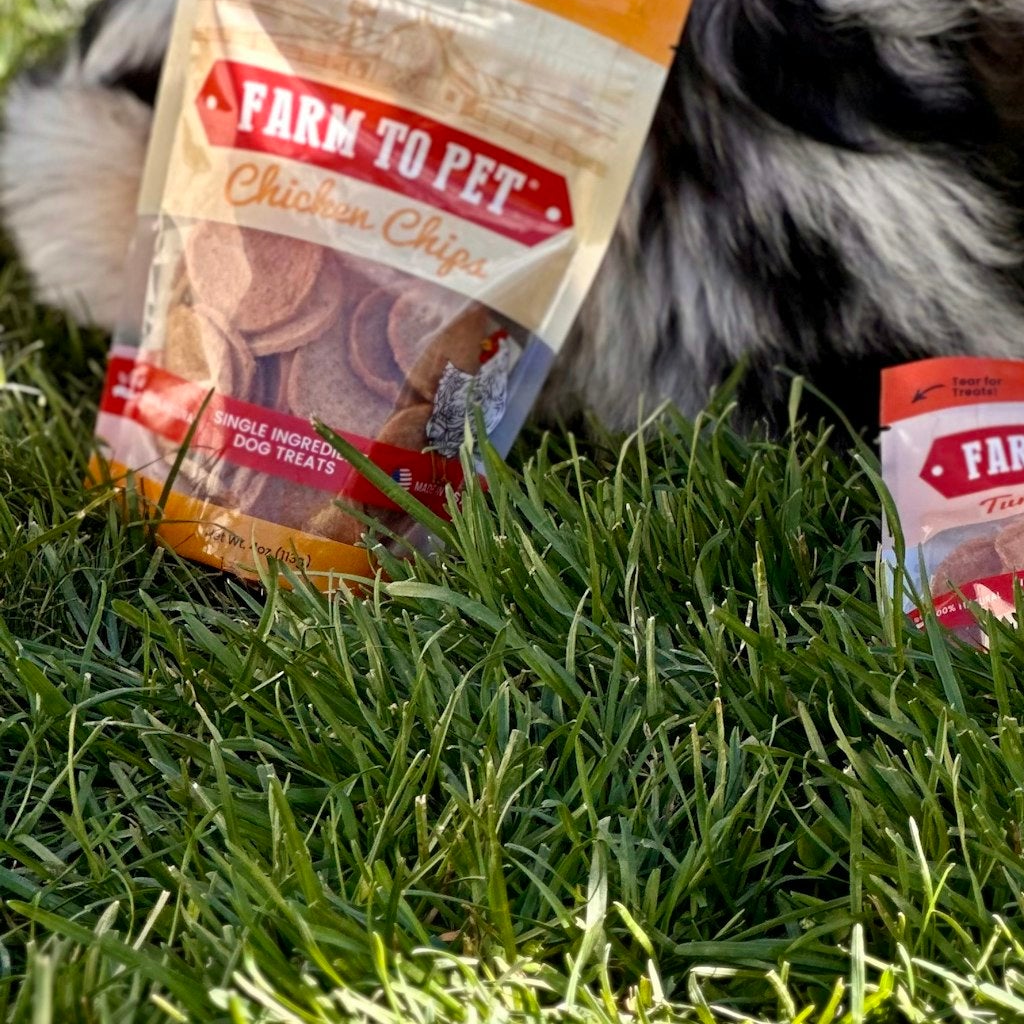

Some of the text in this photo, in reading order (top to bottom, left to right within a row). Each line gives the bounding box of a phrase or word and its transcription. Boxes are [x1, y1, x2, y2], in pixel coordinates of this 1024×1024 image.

[237, 80, 527, 215] FARM TO PET
[224, 162, 489, 280] Chicken Chips
[952, 375, 1003, 386] Tear for
[213, 410, 368, 464] SINGLE INGREDIE
[233, 433, 336, 475] DOG TREATS
[936, 603, 957, 617] 00%
